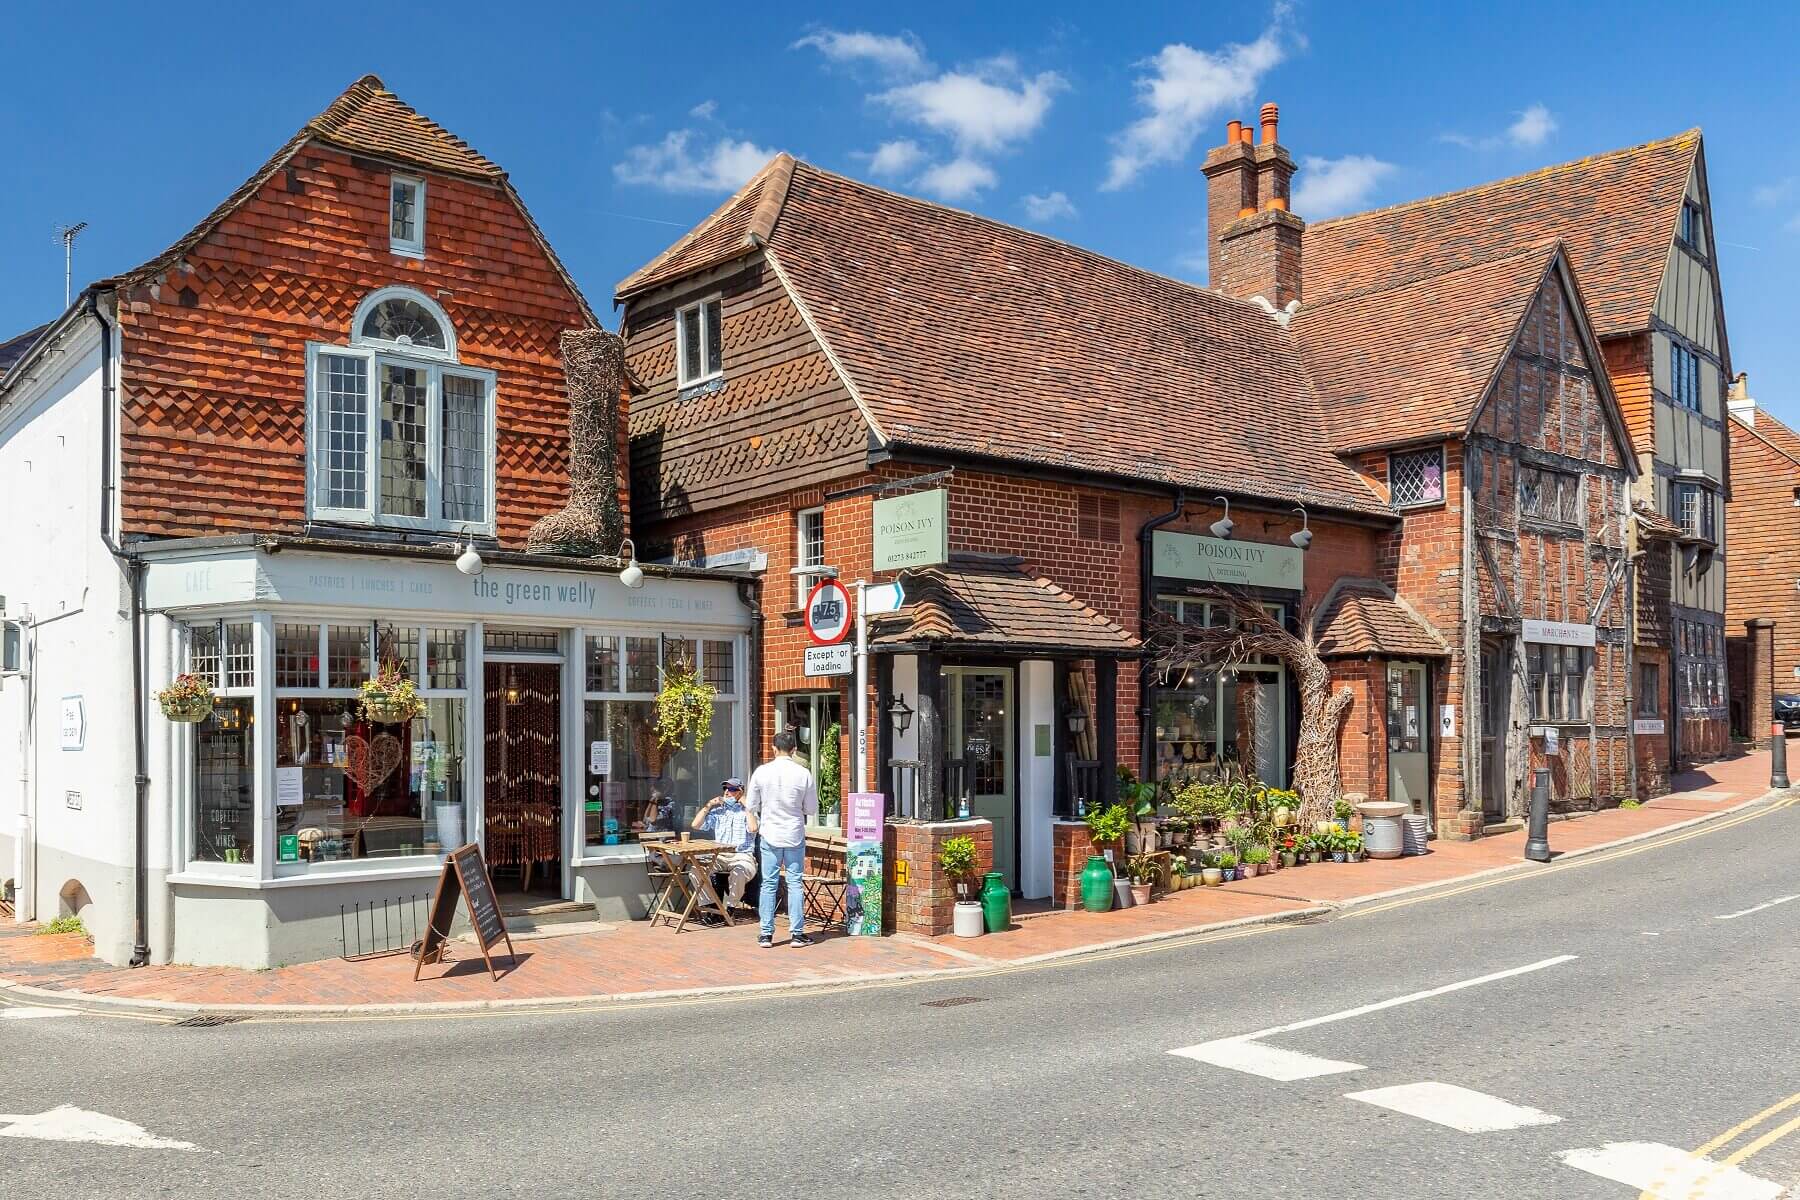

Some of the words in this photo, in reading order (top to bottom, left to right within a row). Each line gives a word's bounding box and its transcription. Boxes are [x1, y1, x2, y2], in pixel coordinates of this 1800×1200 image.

[880, 520, 915, 535] POISON
[917, 517, 934, 529] IVY
[1197, 542, 1242, 561] POISON
[1245, 548, 1265, 563] IVY
[309, 575, 345, 589] PASTRIES
[361, 577, 395, 592] LUNCHES
[473, 575, 499, 598] the
[505, 582, 550, 605] green
[557, 581, 596, 610] welly
[822, 602, 836, 616] 7.5
[807, 650, 834, 660] Except
[837, 650, 848, 658] or
[214, 834, 236, 848] WINES
